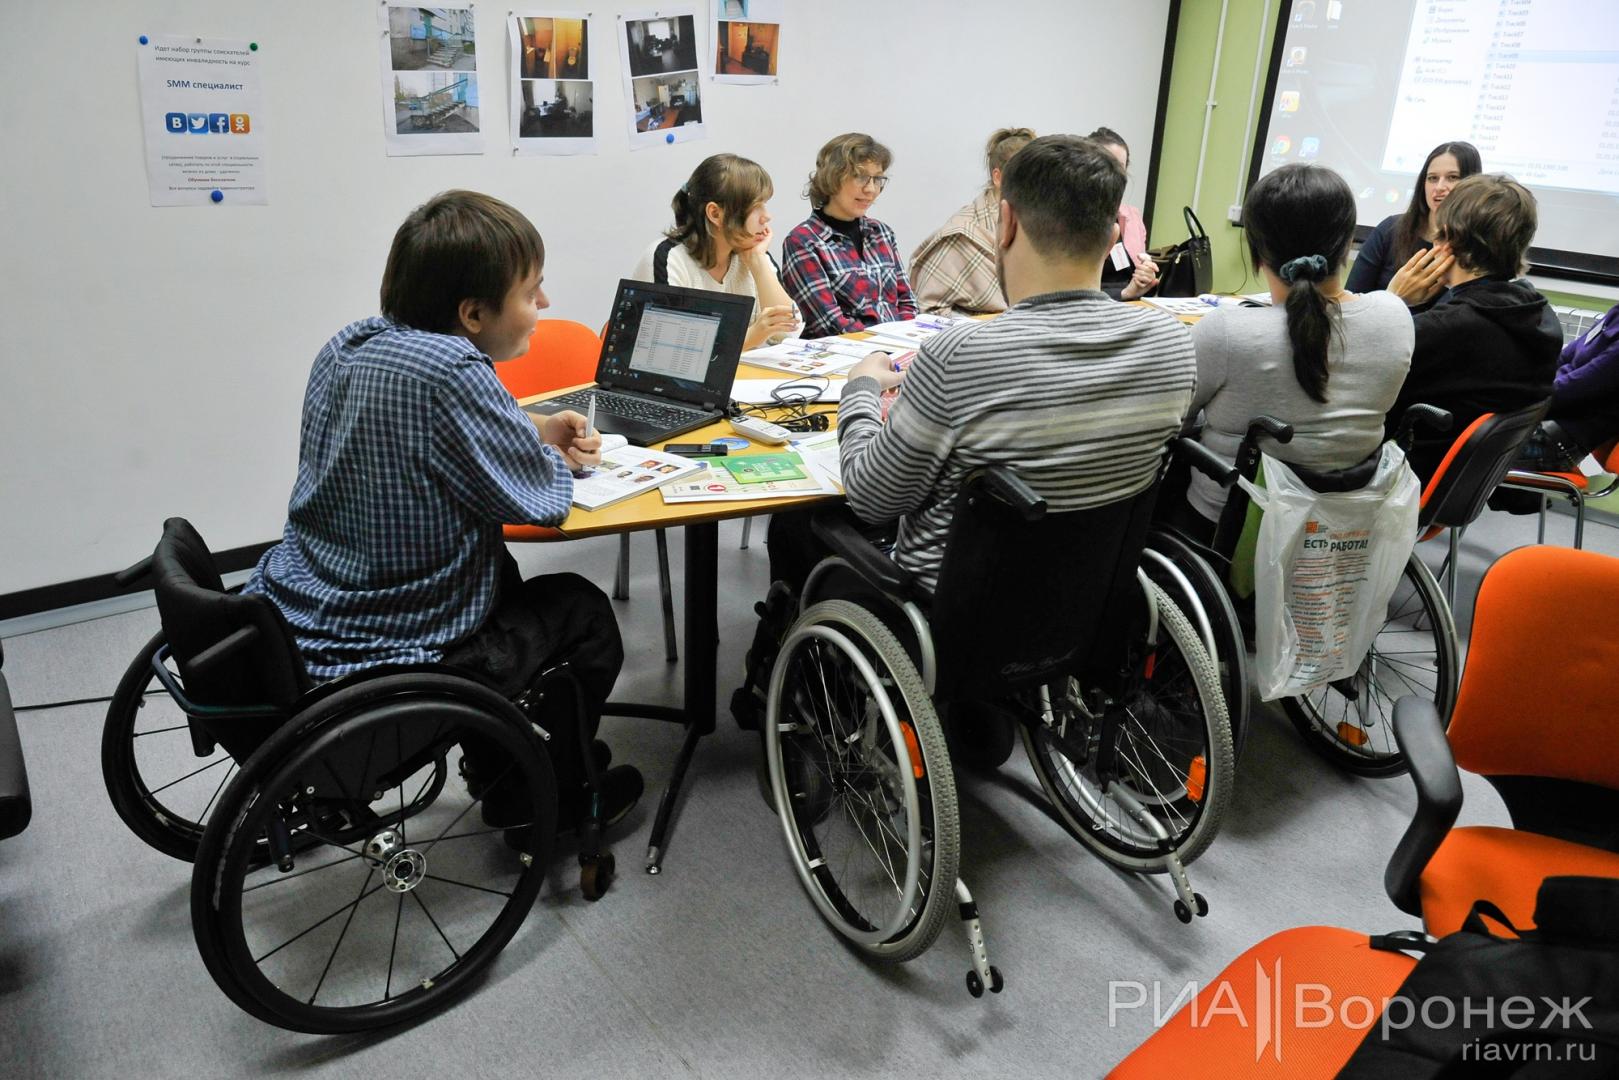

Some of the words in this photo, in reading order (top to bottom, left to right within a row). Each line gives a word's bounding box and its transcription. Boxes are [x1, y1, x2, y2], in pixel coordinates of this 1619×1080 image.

[171, 46, 190, 54] набор
[166, 79, 191, 88] SMM
[192, 82, 243, 91] специалист
[1303, 538, 1329, 549] ЕСТЬ
[1330, 538, 1369, 552] РАБОТА!
